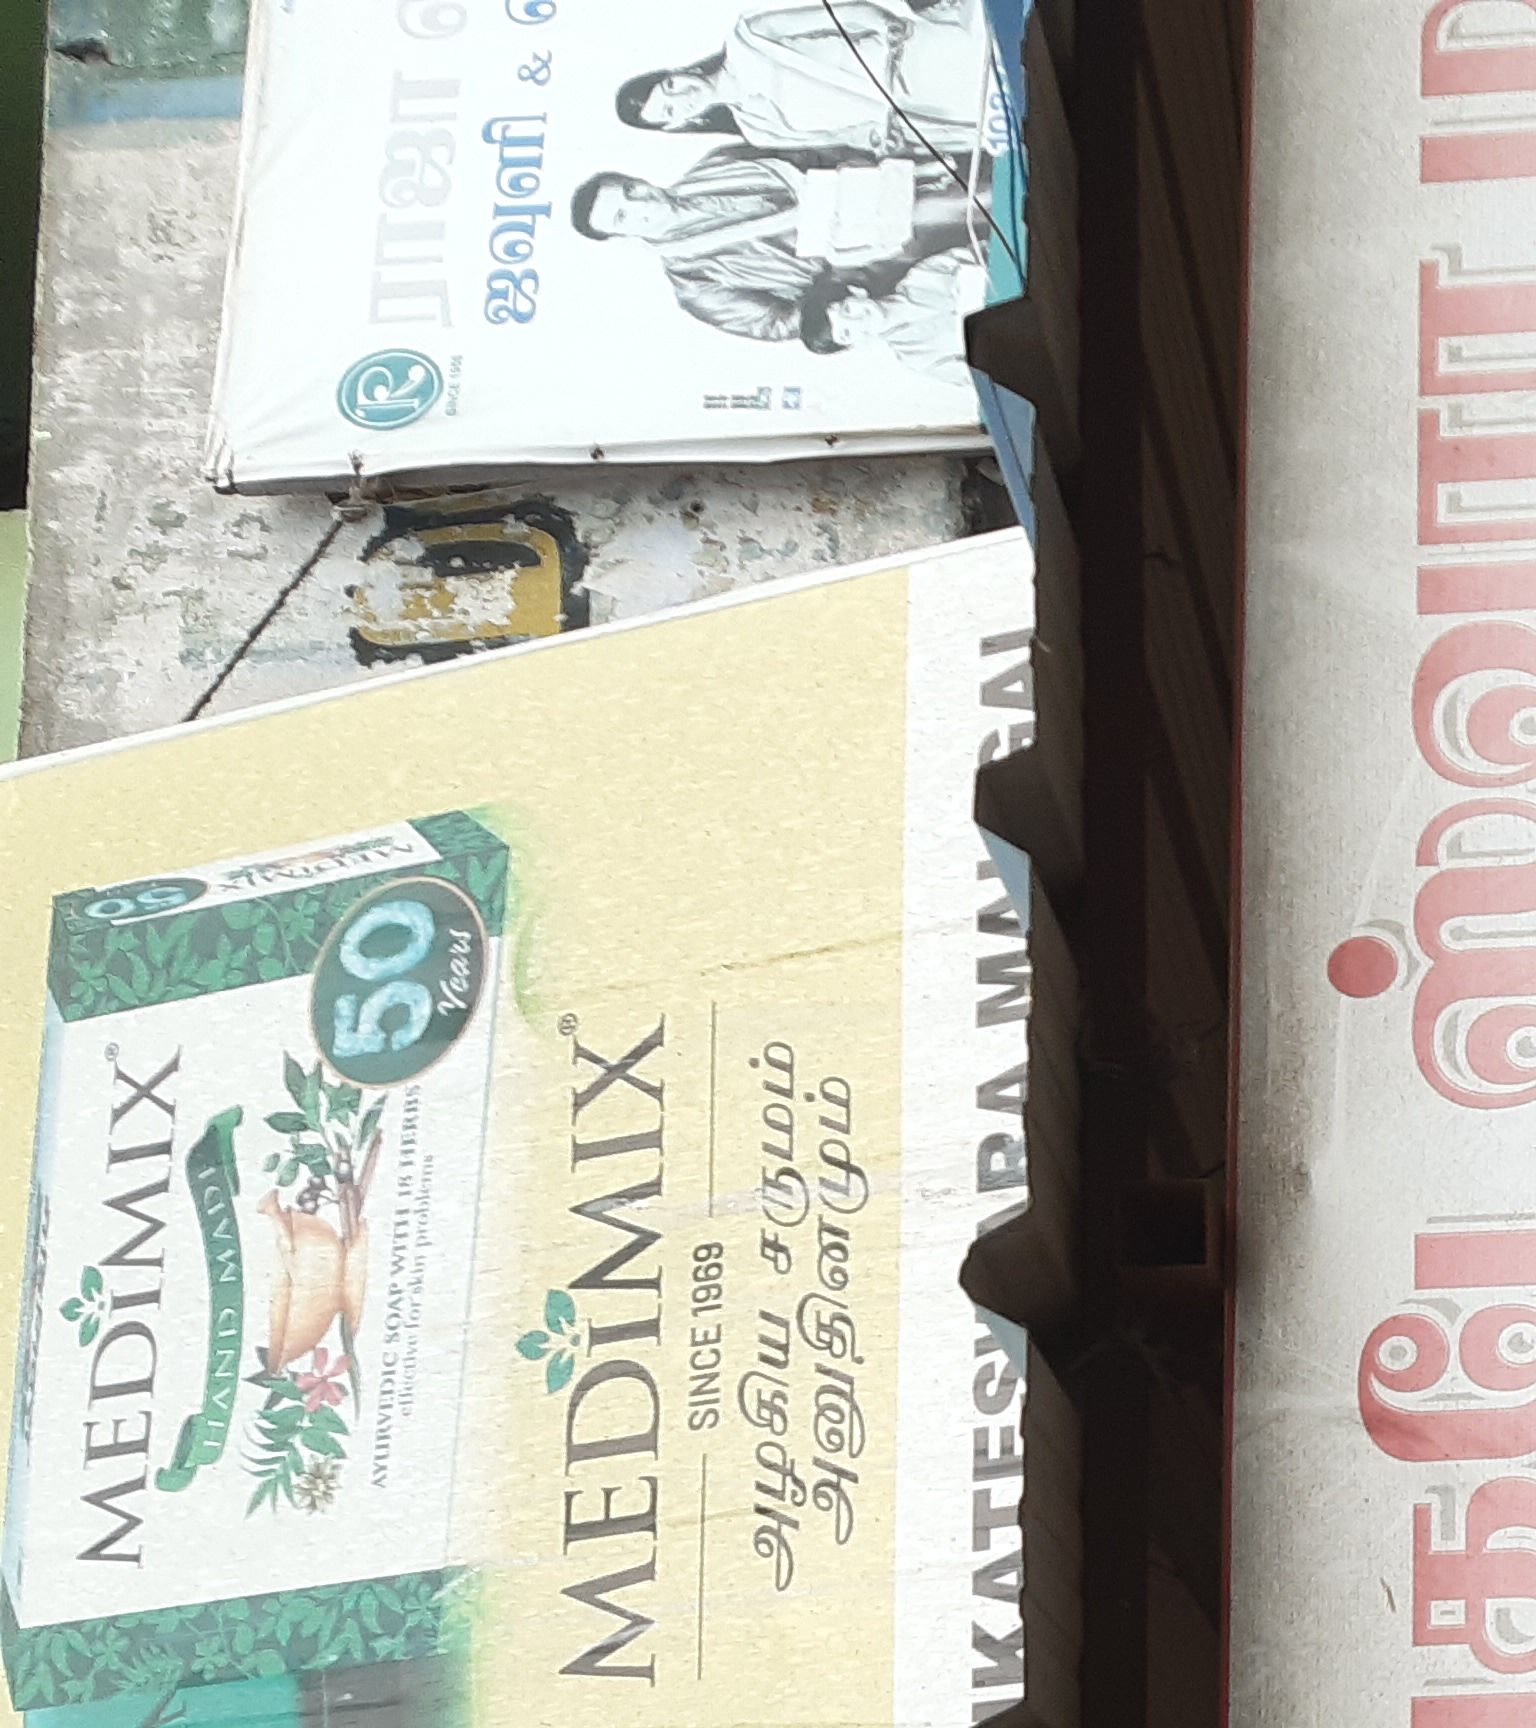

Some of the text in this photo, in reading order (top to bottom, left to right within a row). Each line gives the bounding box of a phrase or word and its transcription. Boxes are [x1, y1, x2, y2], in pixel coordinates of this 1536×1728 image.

[517, 49, 553, 87] &
[367, 68, 462, 328] ராஜா
[481, 111, 554, 326] ஜவுளி
[334, 900, 436, 1055] 50
[437, 928, 472, 1017] Years
[399, 1084, 421, 1169] HERBS
[384, 1284, 403, 1343] SOAP
[388, 1209, 411, 1279] WITH
[400, 1334, 419, 1416] effective
[412, 1154, 435, 1248] problems
[738, 1039, 809, 1592] அழகிய சருமம்
[797, 1075, 870, 1545] அனுதினமும்
[203, 1307, 237, 1449] HAND
[557, 1013, 665, 1687] MEDIMIX
[688, 1241, 723, 1431] SINCE 1969
[371, 1352, 398, 1489] AYURVEDIC
